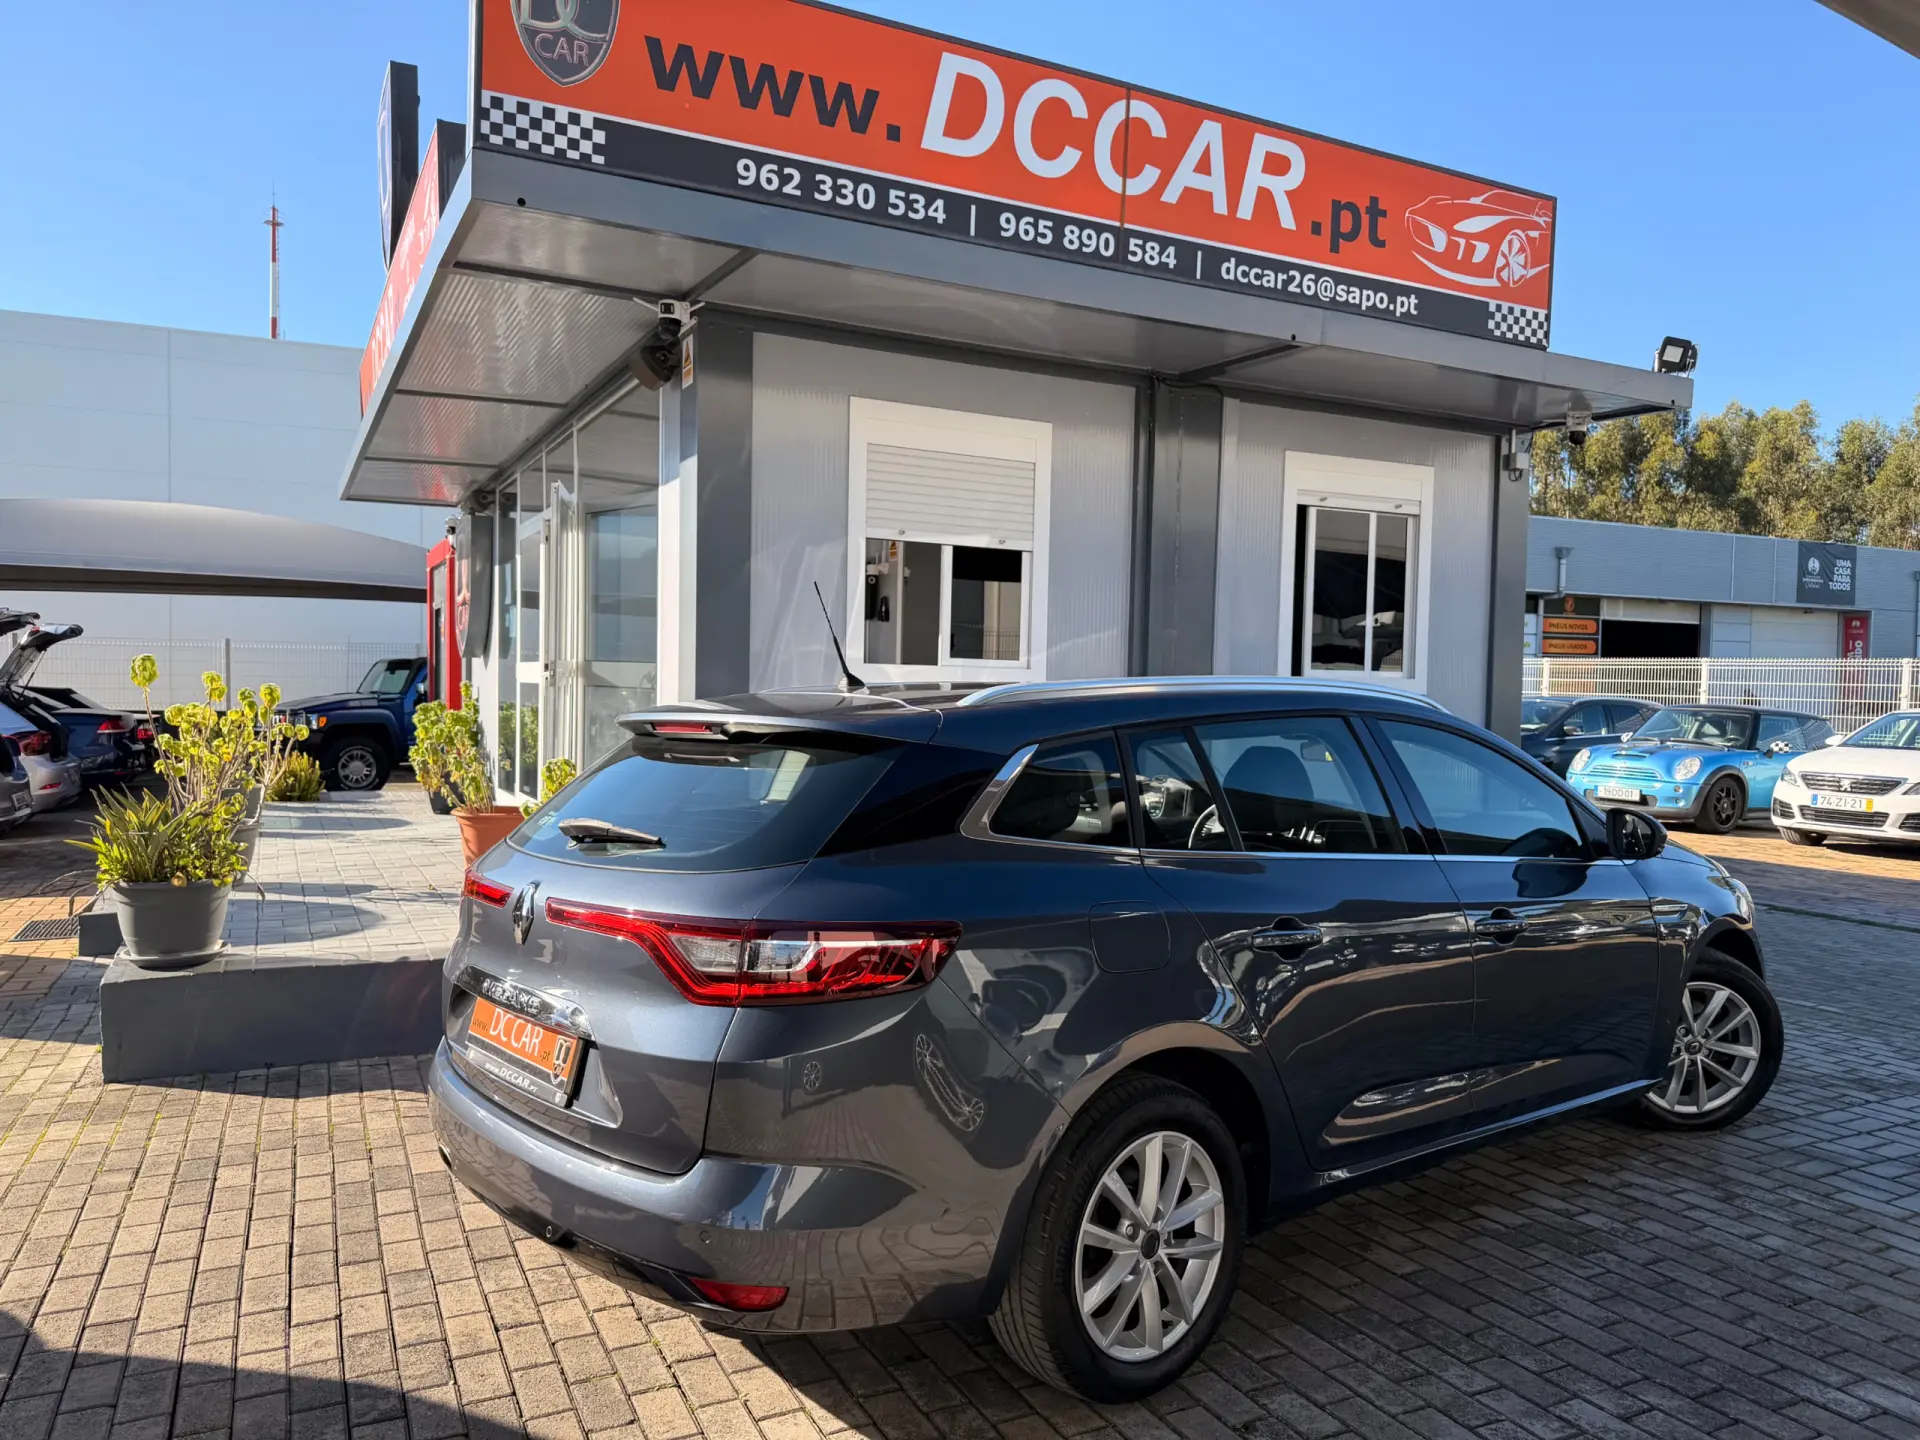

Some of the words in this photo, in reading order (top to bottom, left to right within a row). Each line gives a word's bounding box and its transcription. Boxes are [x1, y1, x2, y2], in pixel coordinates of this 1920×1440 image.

[534, 33, 589, 67] CAR
[736, 157, 802, 197] 962
[813, 173, 876, 211] 330
[887, 188, 947, 225] 534
[999, 211, 1054, 245] 965
[1063, 226, 1115, 258] 890
[1127, 239, 1178, 270] 584
[1220, 257, 1419, 316] dccar26@sapo.pt
[1836, 559, 1851, 567] UMA
[1834, 567, 1851, 575] CASA
[1833, 575, 1851, 583] PARA
[1829, 582, 1851, 591] TODOS
[1549, 622, 1567, 630] PNEUS
